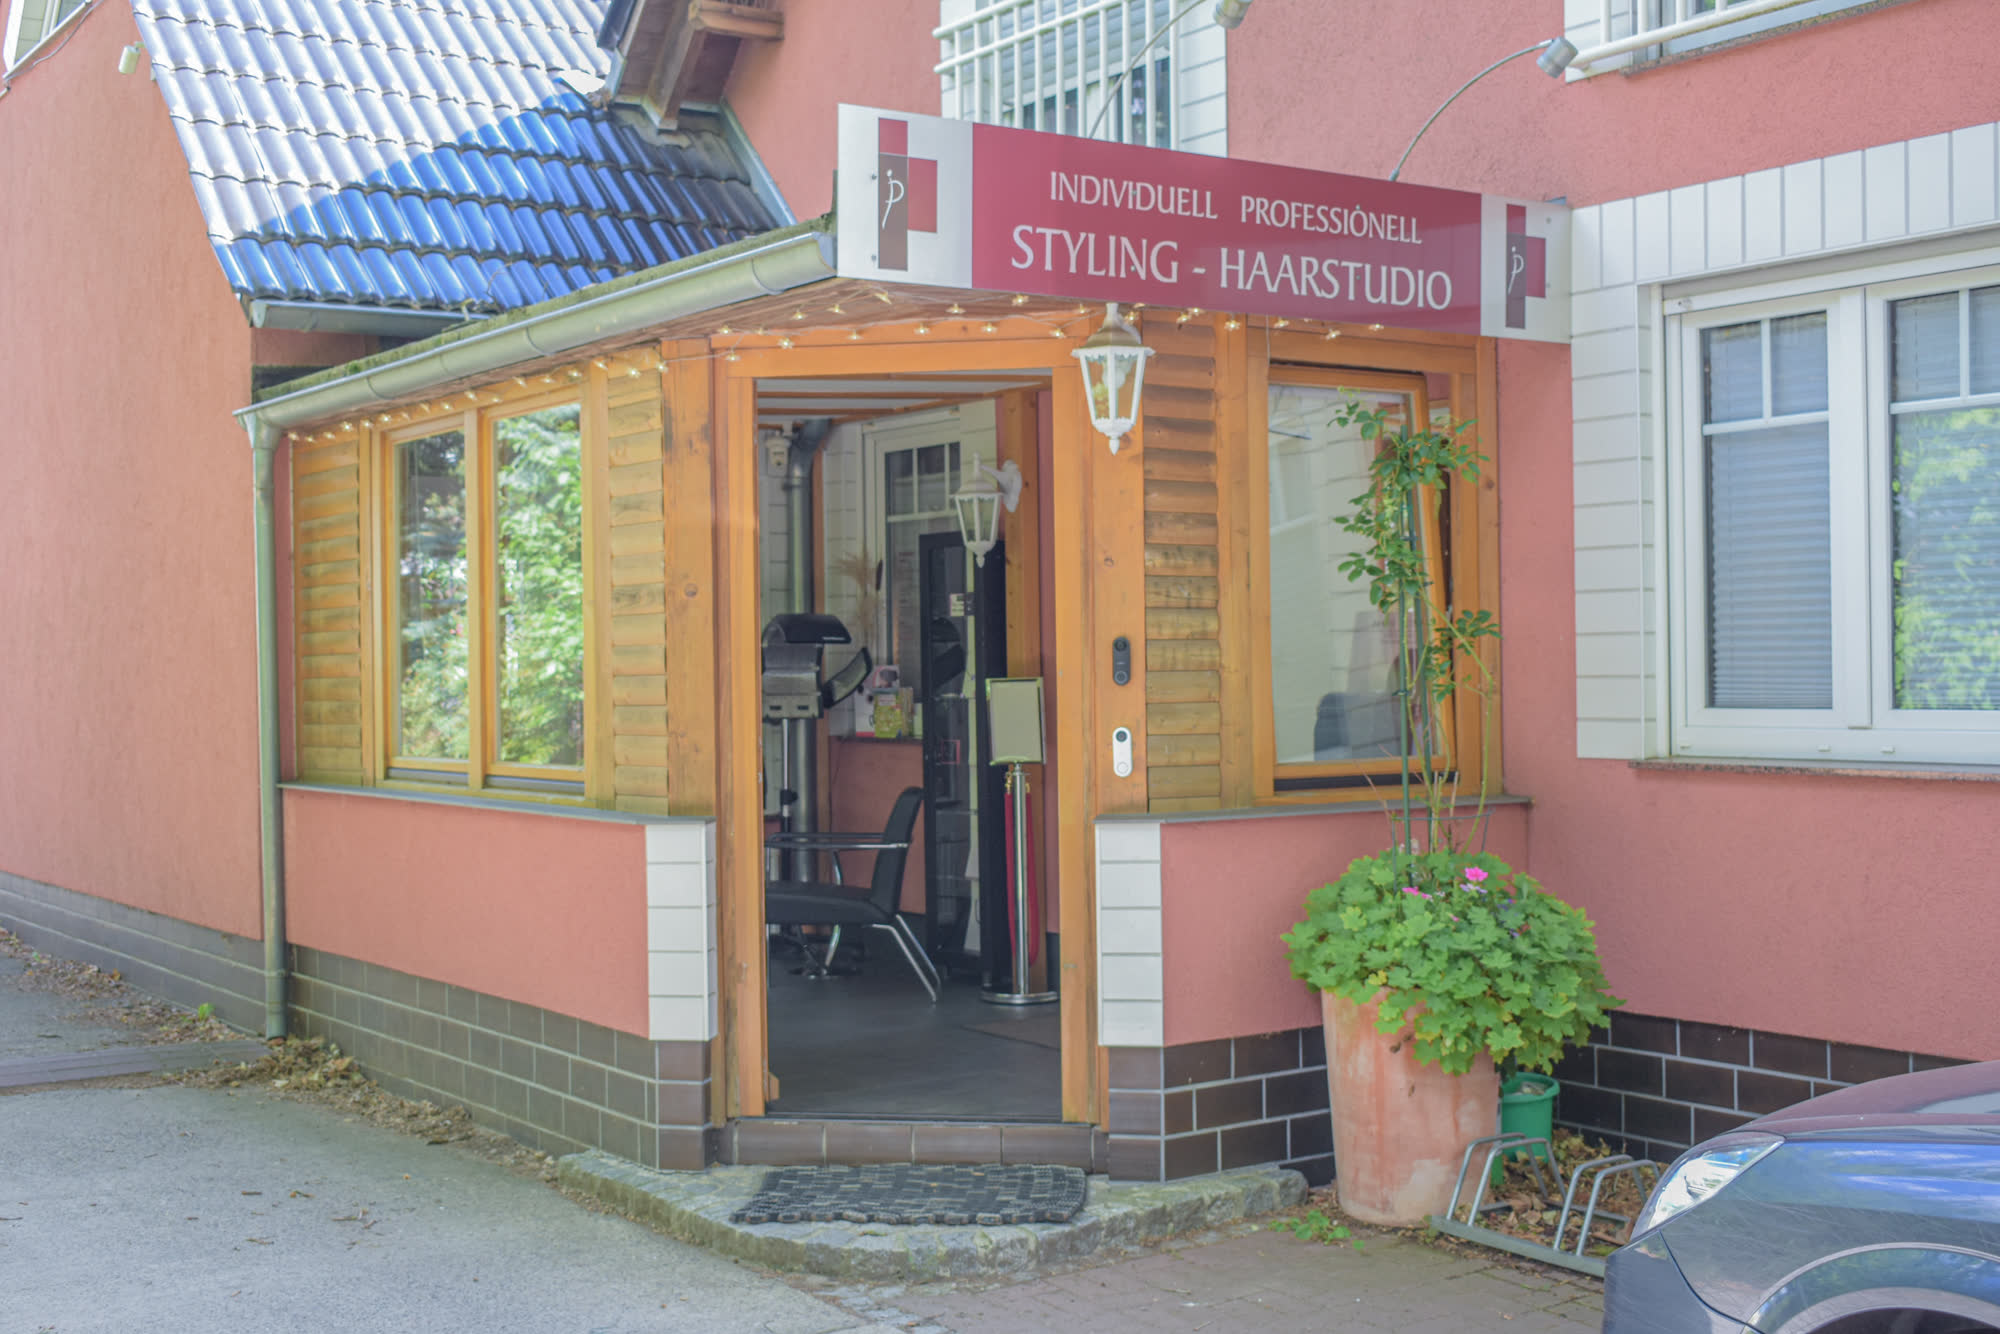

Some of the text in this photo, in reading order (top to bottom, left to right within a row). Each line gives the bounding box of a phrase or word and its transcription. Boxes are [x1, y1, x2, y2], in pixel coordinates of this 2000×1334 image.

[1050, 171, 1423, 245] INDIVIDUELL PROFESSIONELL
[1011, 224, 1179, 284] STYLING
[1219, 247, 1453, 311] HAARSTUDIO
